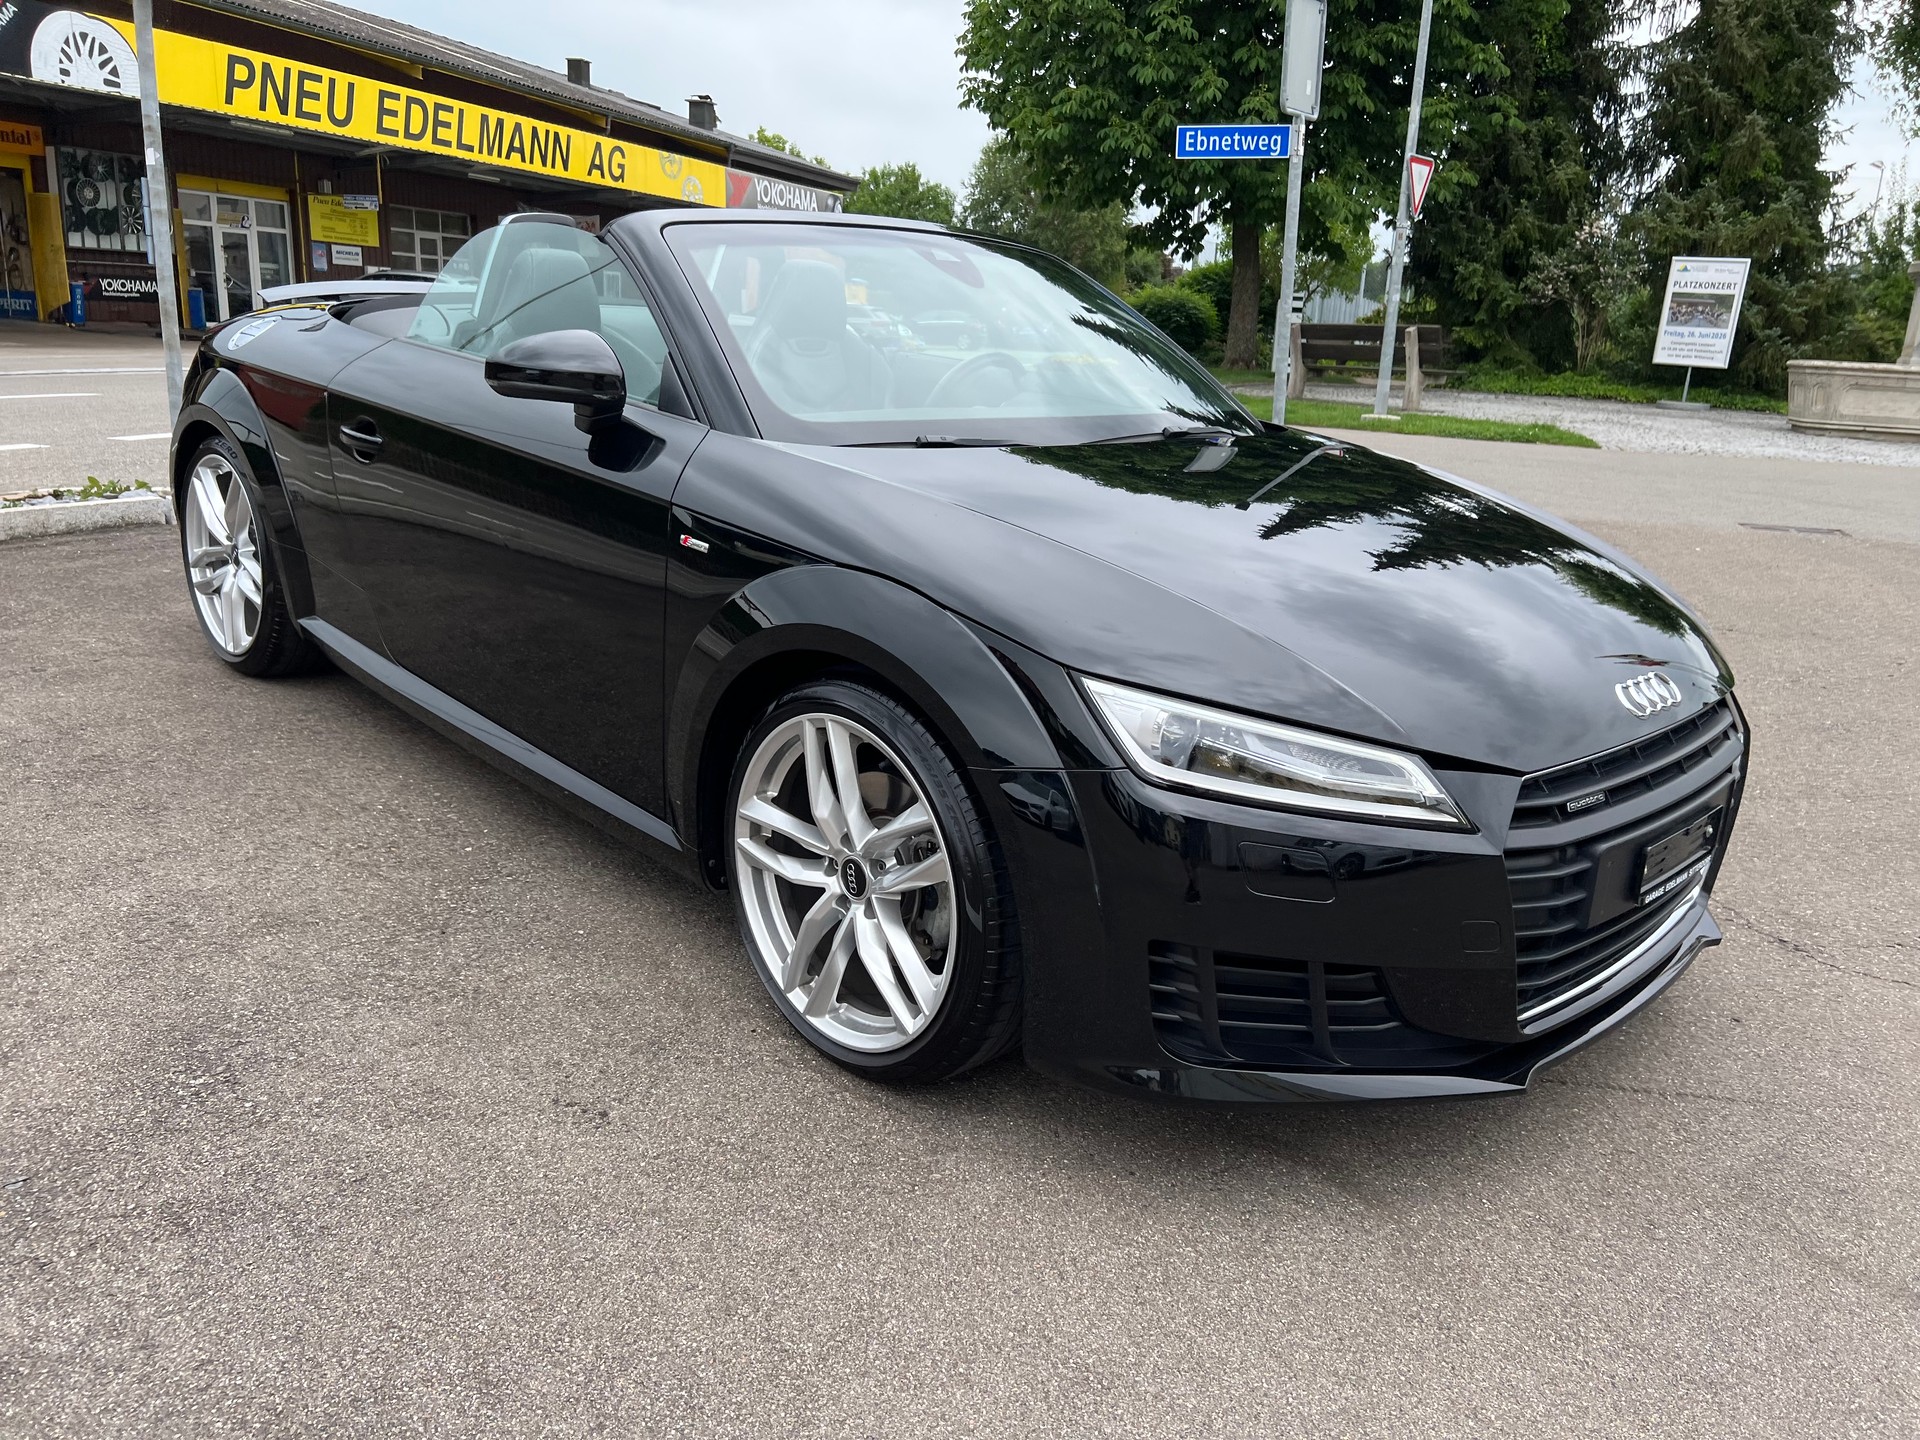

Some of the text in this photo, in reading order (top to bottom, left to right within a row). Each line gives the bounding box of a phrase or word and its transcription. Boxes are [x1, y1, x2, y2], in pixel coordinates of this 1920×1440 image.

[225, 53, 626, 183] PNEU EDELMANN AG
[1185, 130, 1281, 156] Ebnetweg
[313, 196, 329, 205] Pneu
[755, 178, 818, 212] YOKOHAMA
[99, 278, 158, 293] YOKOHAMA
[1673, 280, 1737, 290] PLATZKONZERT
[1664, 330, 1686, 338] Freitag,
[214, 437, 238, 459] ZERO
[1570, 794, 1604, 810] quattro
[1645, 886, 1665, 903] GARAGE
[1666, 871, 1688, 891] EDELMANN
